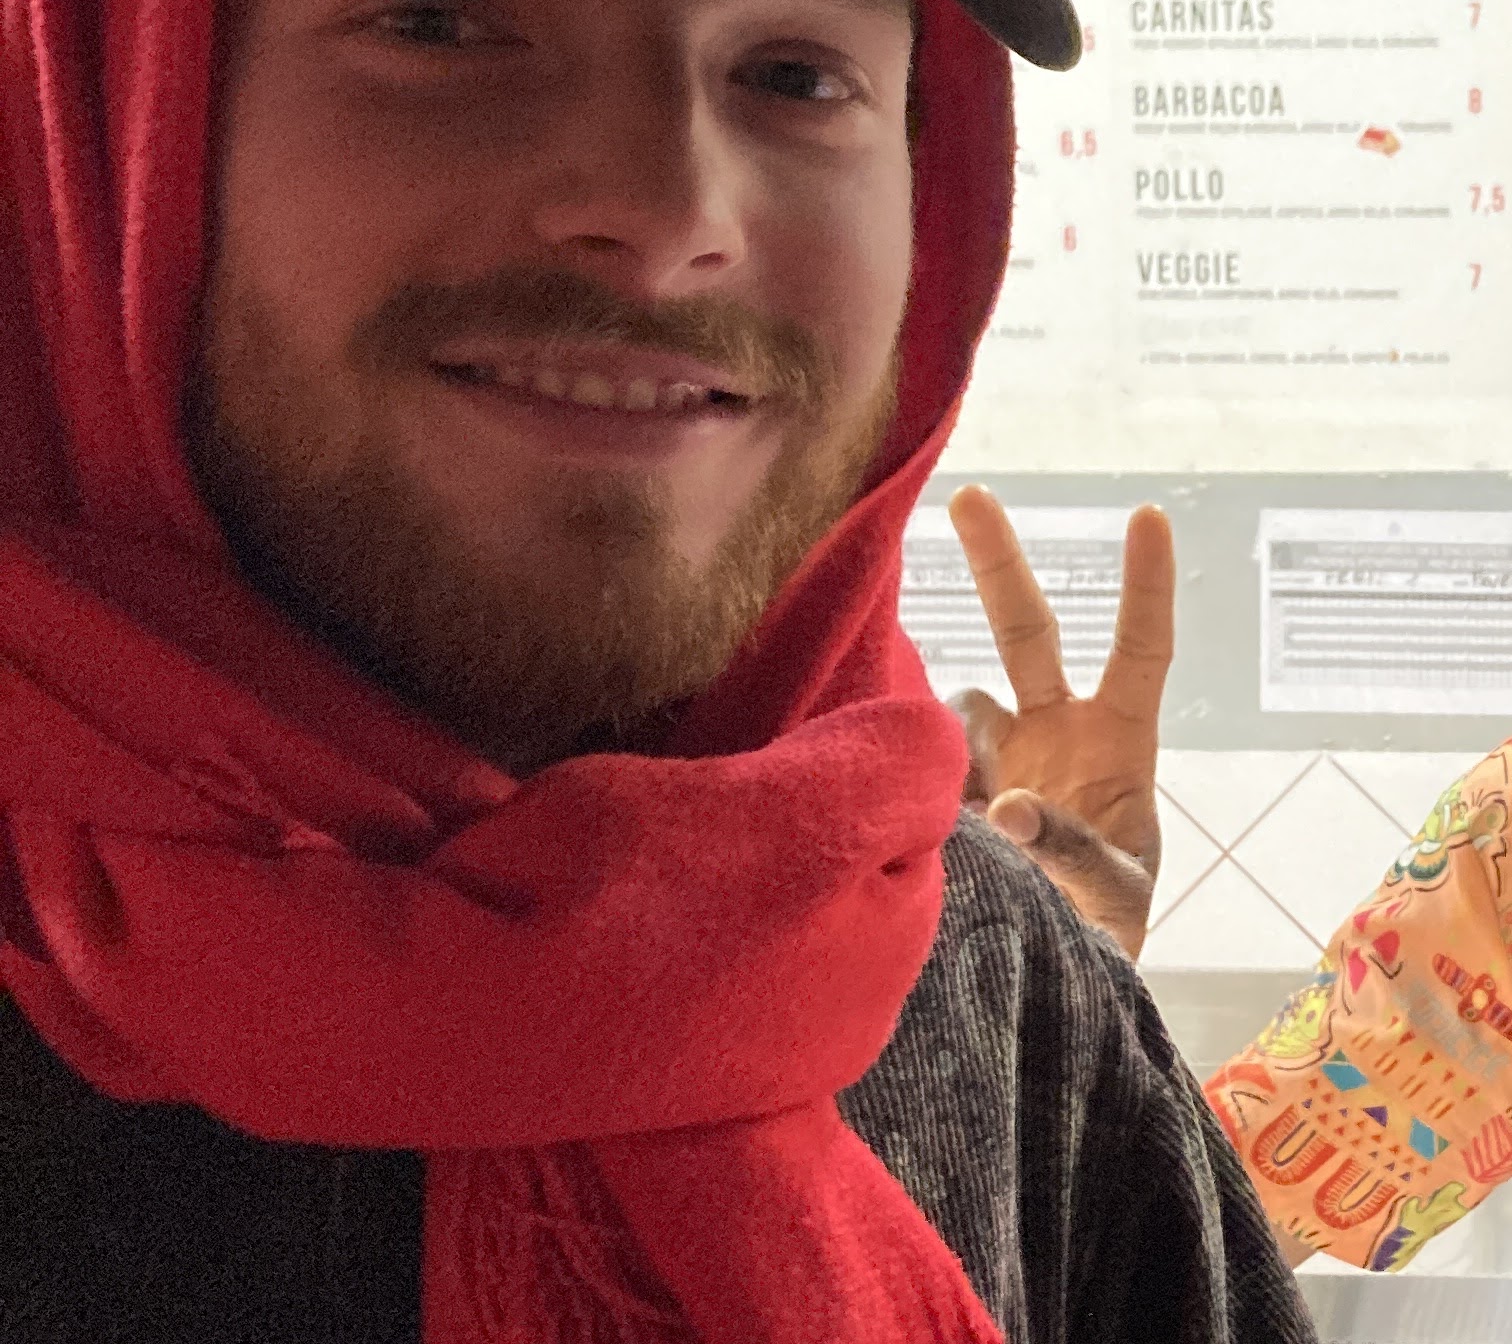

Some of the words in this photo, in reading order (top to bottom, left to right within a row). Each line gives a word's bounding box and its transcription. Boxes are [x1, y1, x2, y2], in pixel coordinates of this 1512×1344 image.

[1132, 0, 1274, 32] CARNITAS
[1468, 2, 1482, 29] 7
[1134, 85, 1285, 117] BARBACOA
[1134, 169, 1225, 202] POLLO
[1468, 184, 1506, 214] 7,5
[1137, 252, 1241, 285] VEGGIE
[1468, 263, 1482, 290] 7
